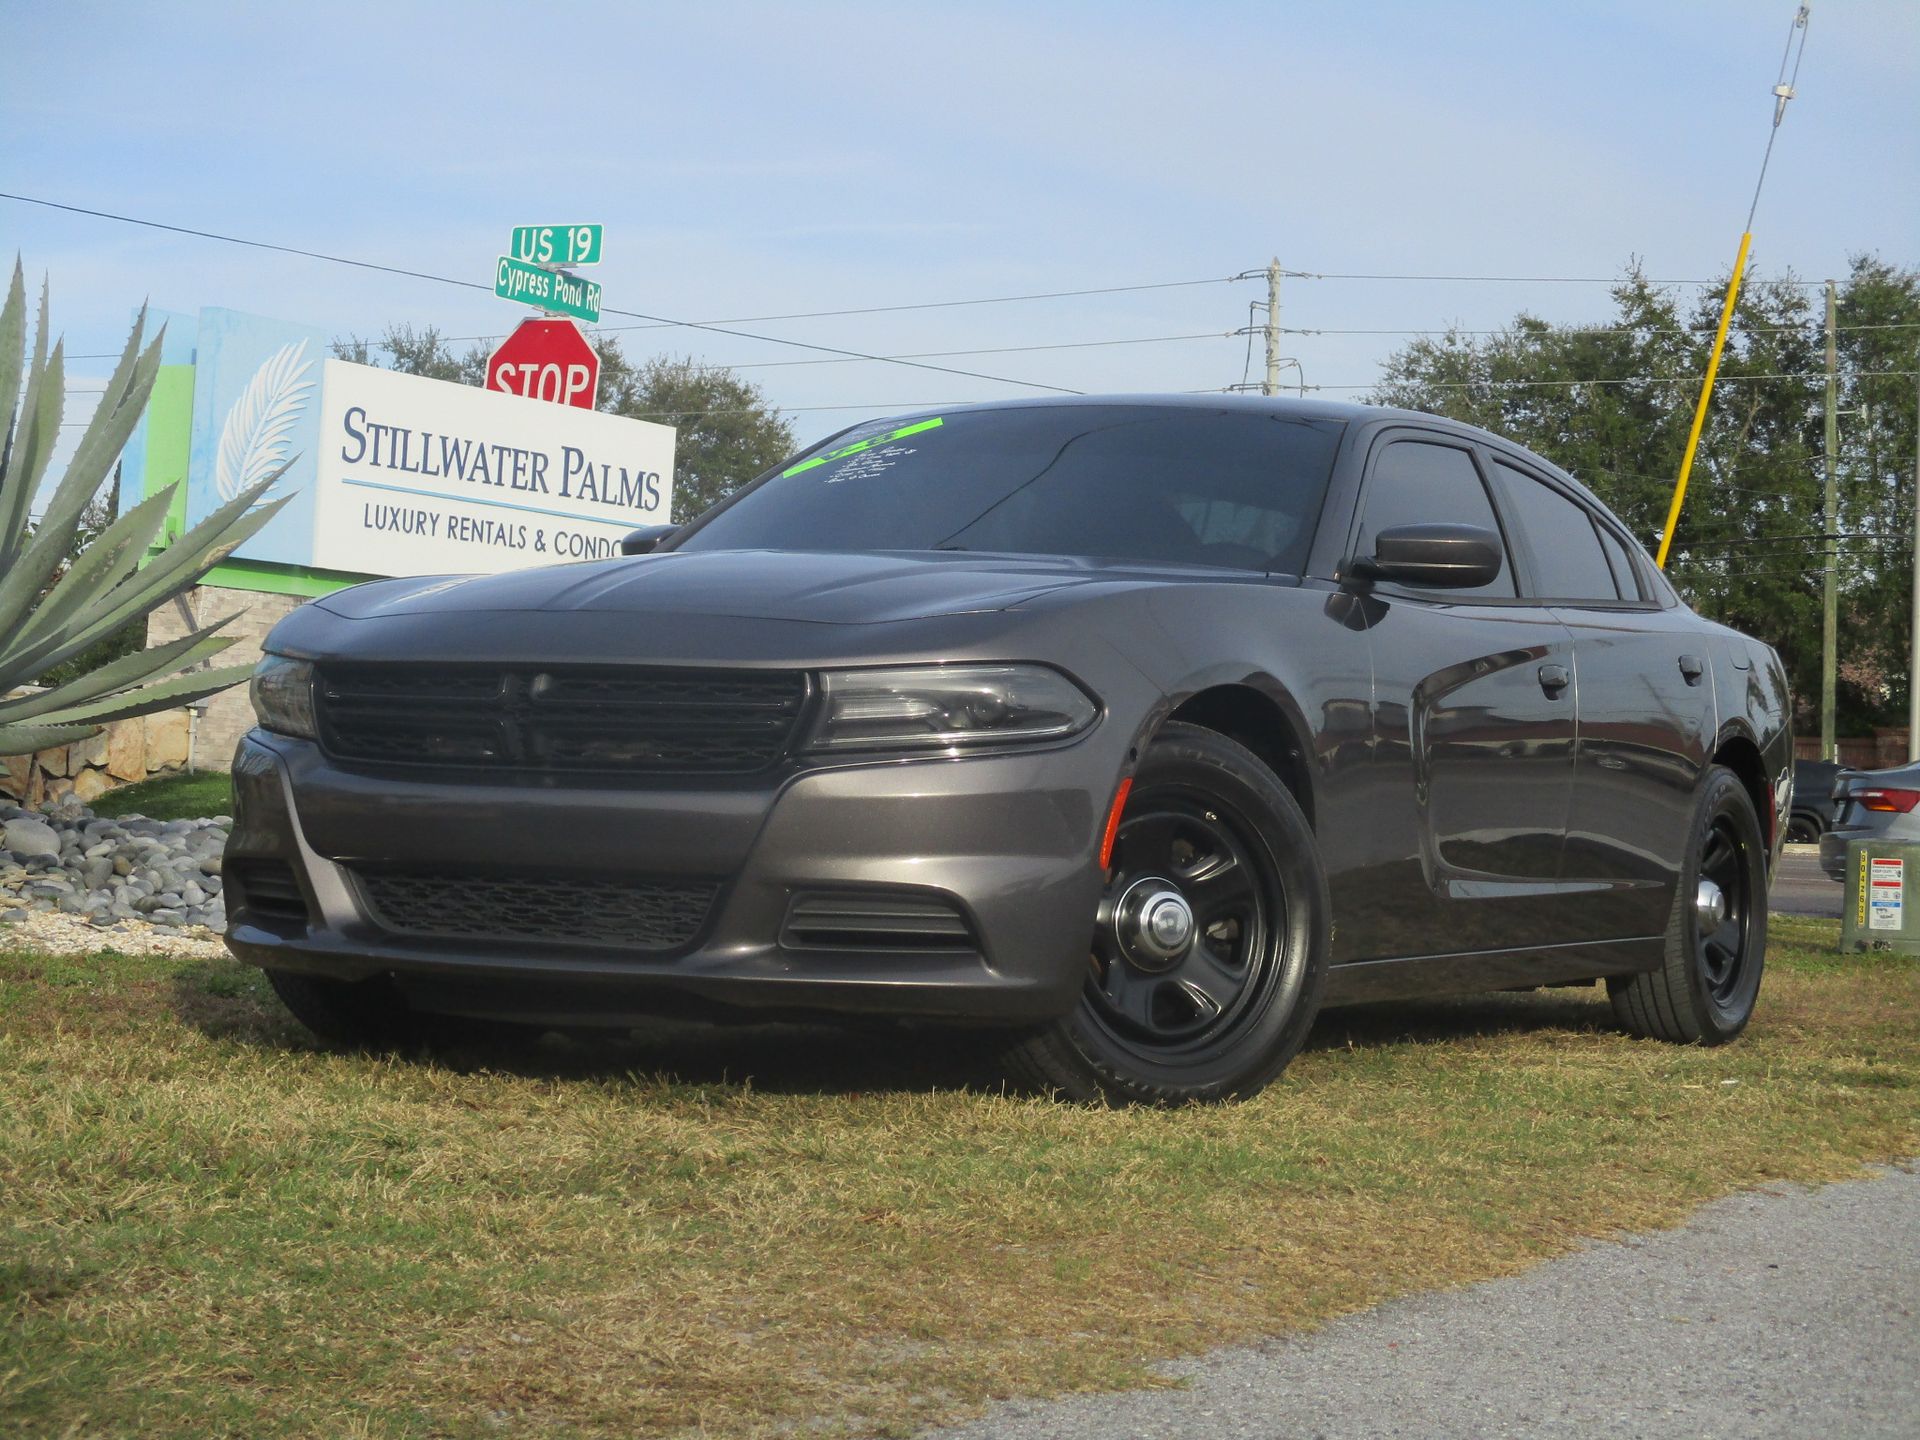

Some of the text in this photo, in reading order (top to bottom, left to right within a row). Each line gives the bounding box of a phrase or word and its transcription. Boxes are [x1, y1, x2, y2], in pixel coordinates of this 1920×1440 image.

[520, 227, 592, 262] US 19
[498, 259, 601, 313] Cypress Pond Rd
[495, 362, 590, 406] STOP
[341, 406, 661, 512] STILLWATER PALMS
[364, 503, 440, 537] LUXURY
[447, 515, 527, 549] RENTALS
[534, 528, 547, 552] &
